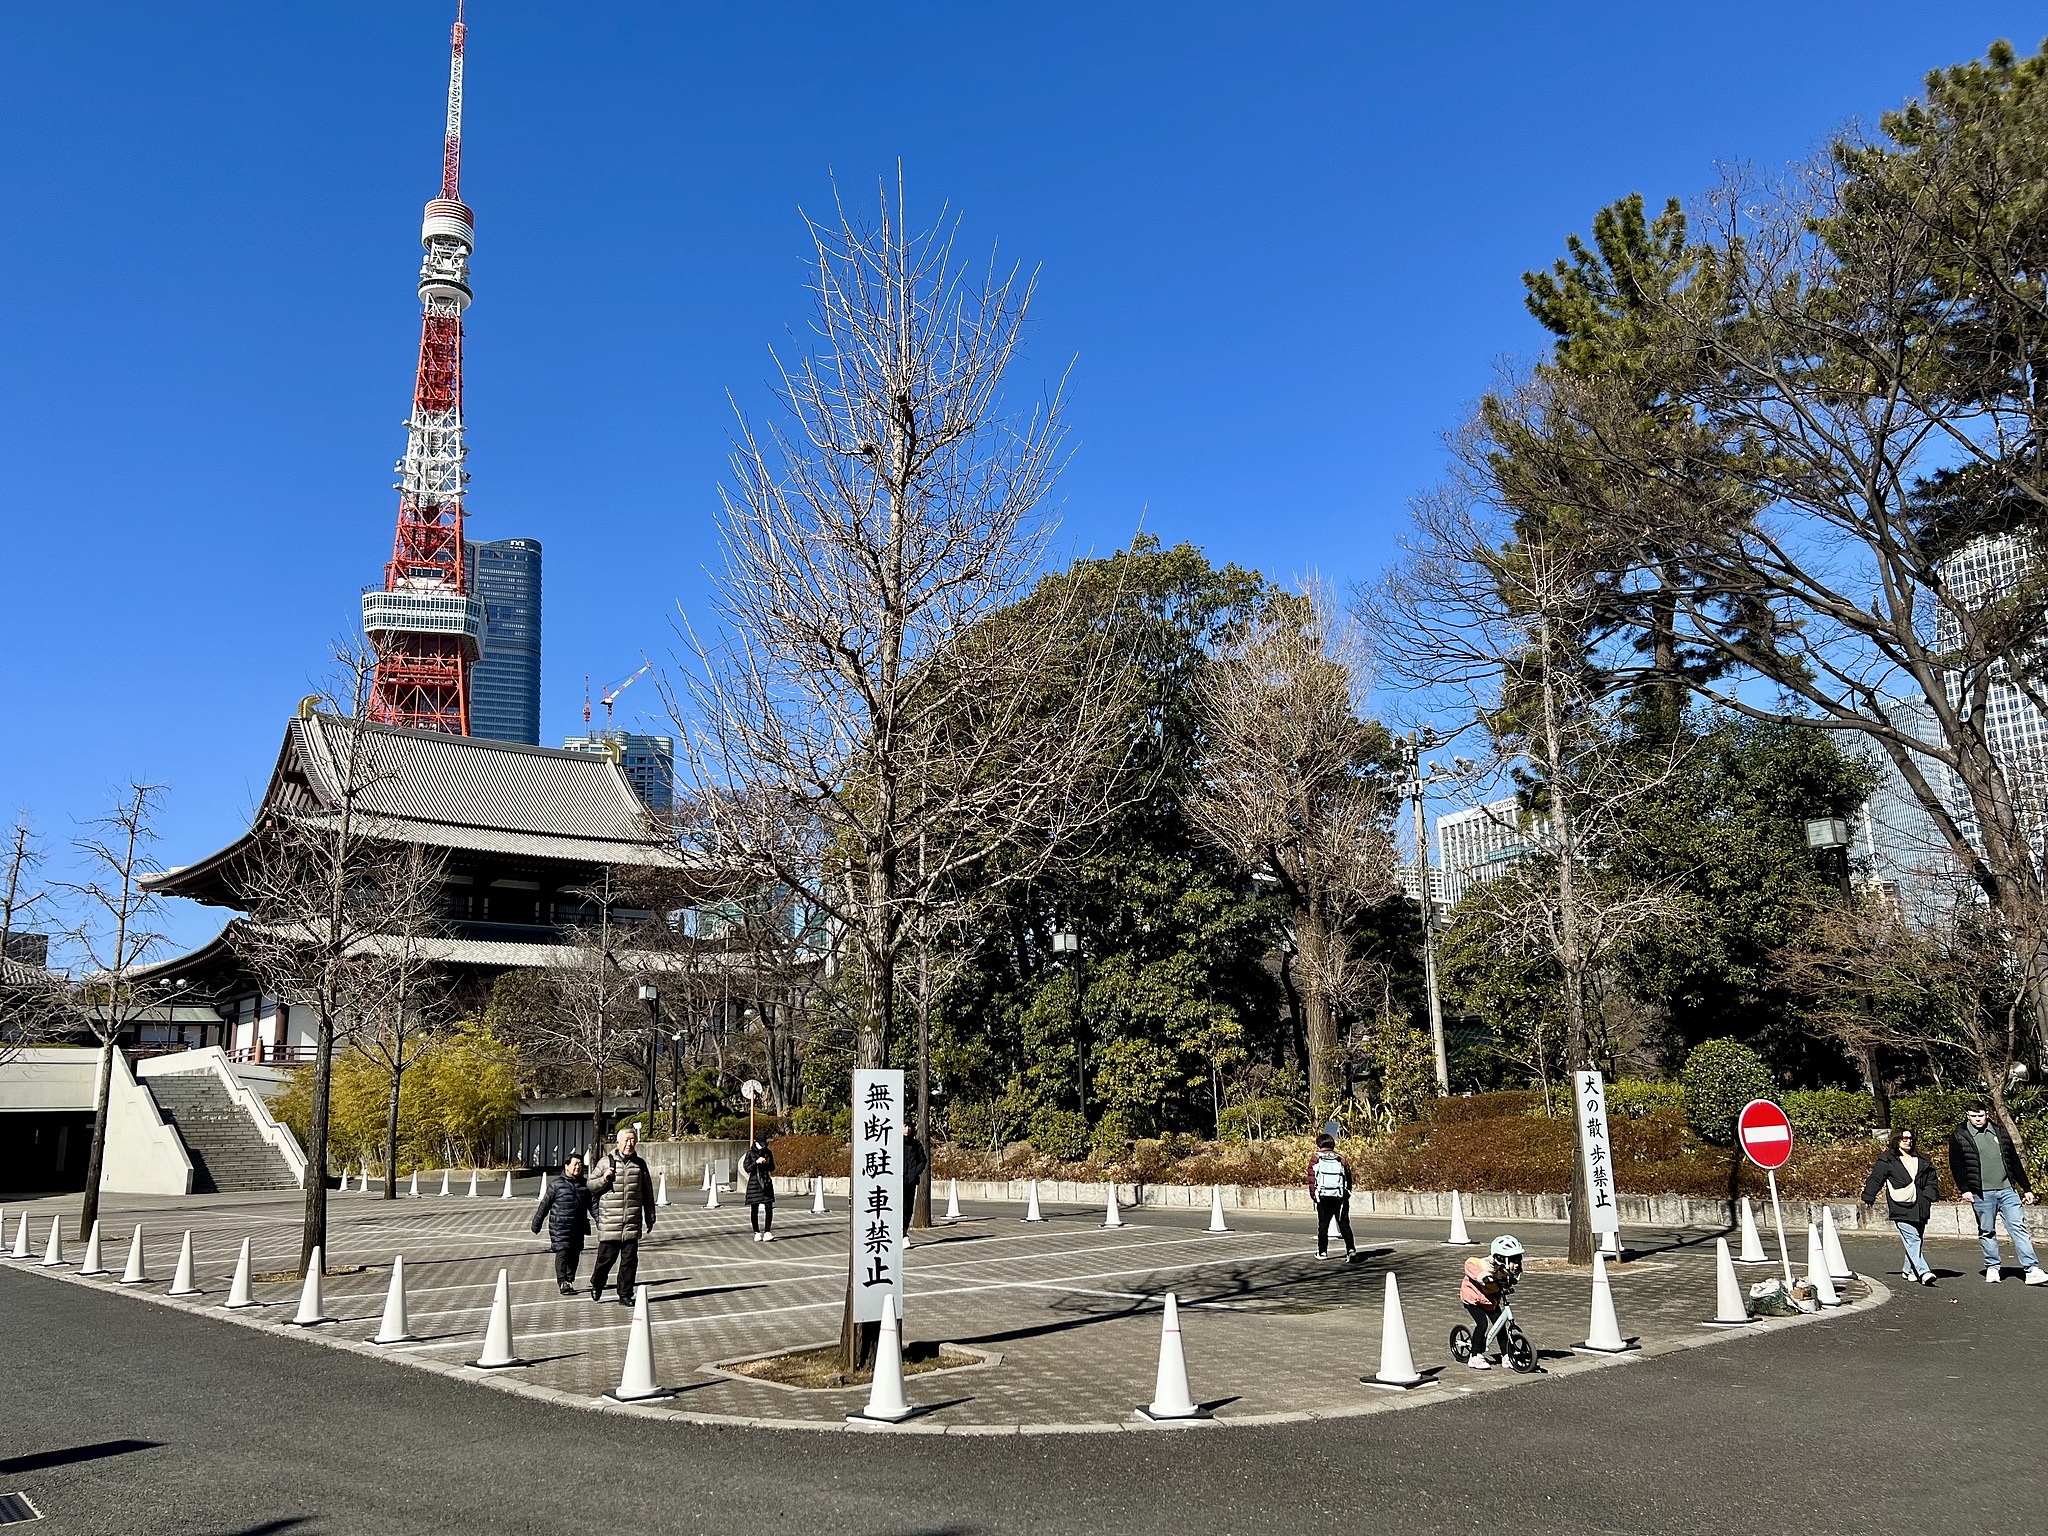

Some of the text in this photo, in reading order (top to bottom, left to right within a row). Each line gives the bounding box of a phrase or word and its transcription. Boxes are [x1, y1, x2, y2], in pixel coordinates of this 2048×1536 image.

[862, 1082, 894, 1288] 無断駐車禁止
[1584, 1075, 1612, 1208] 犬の散歩禁止
